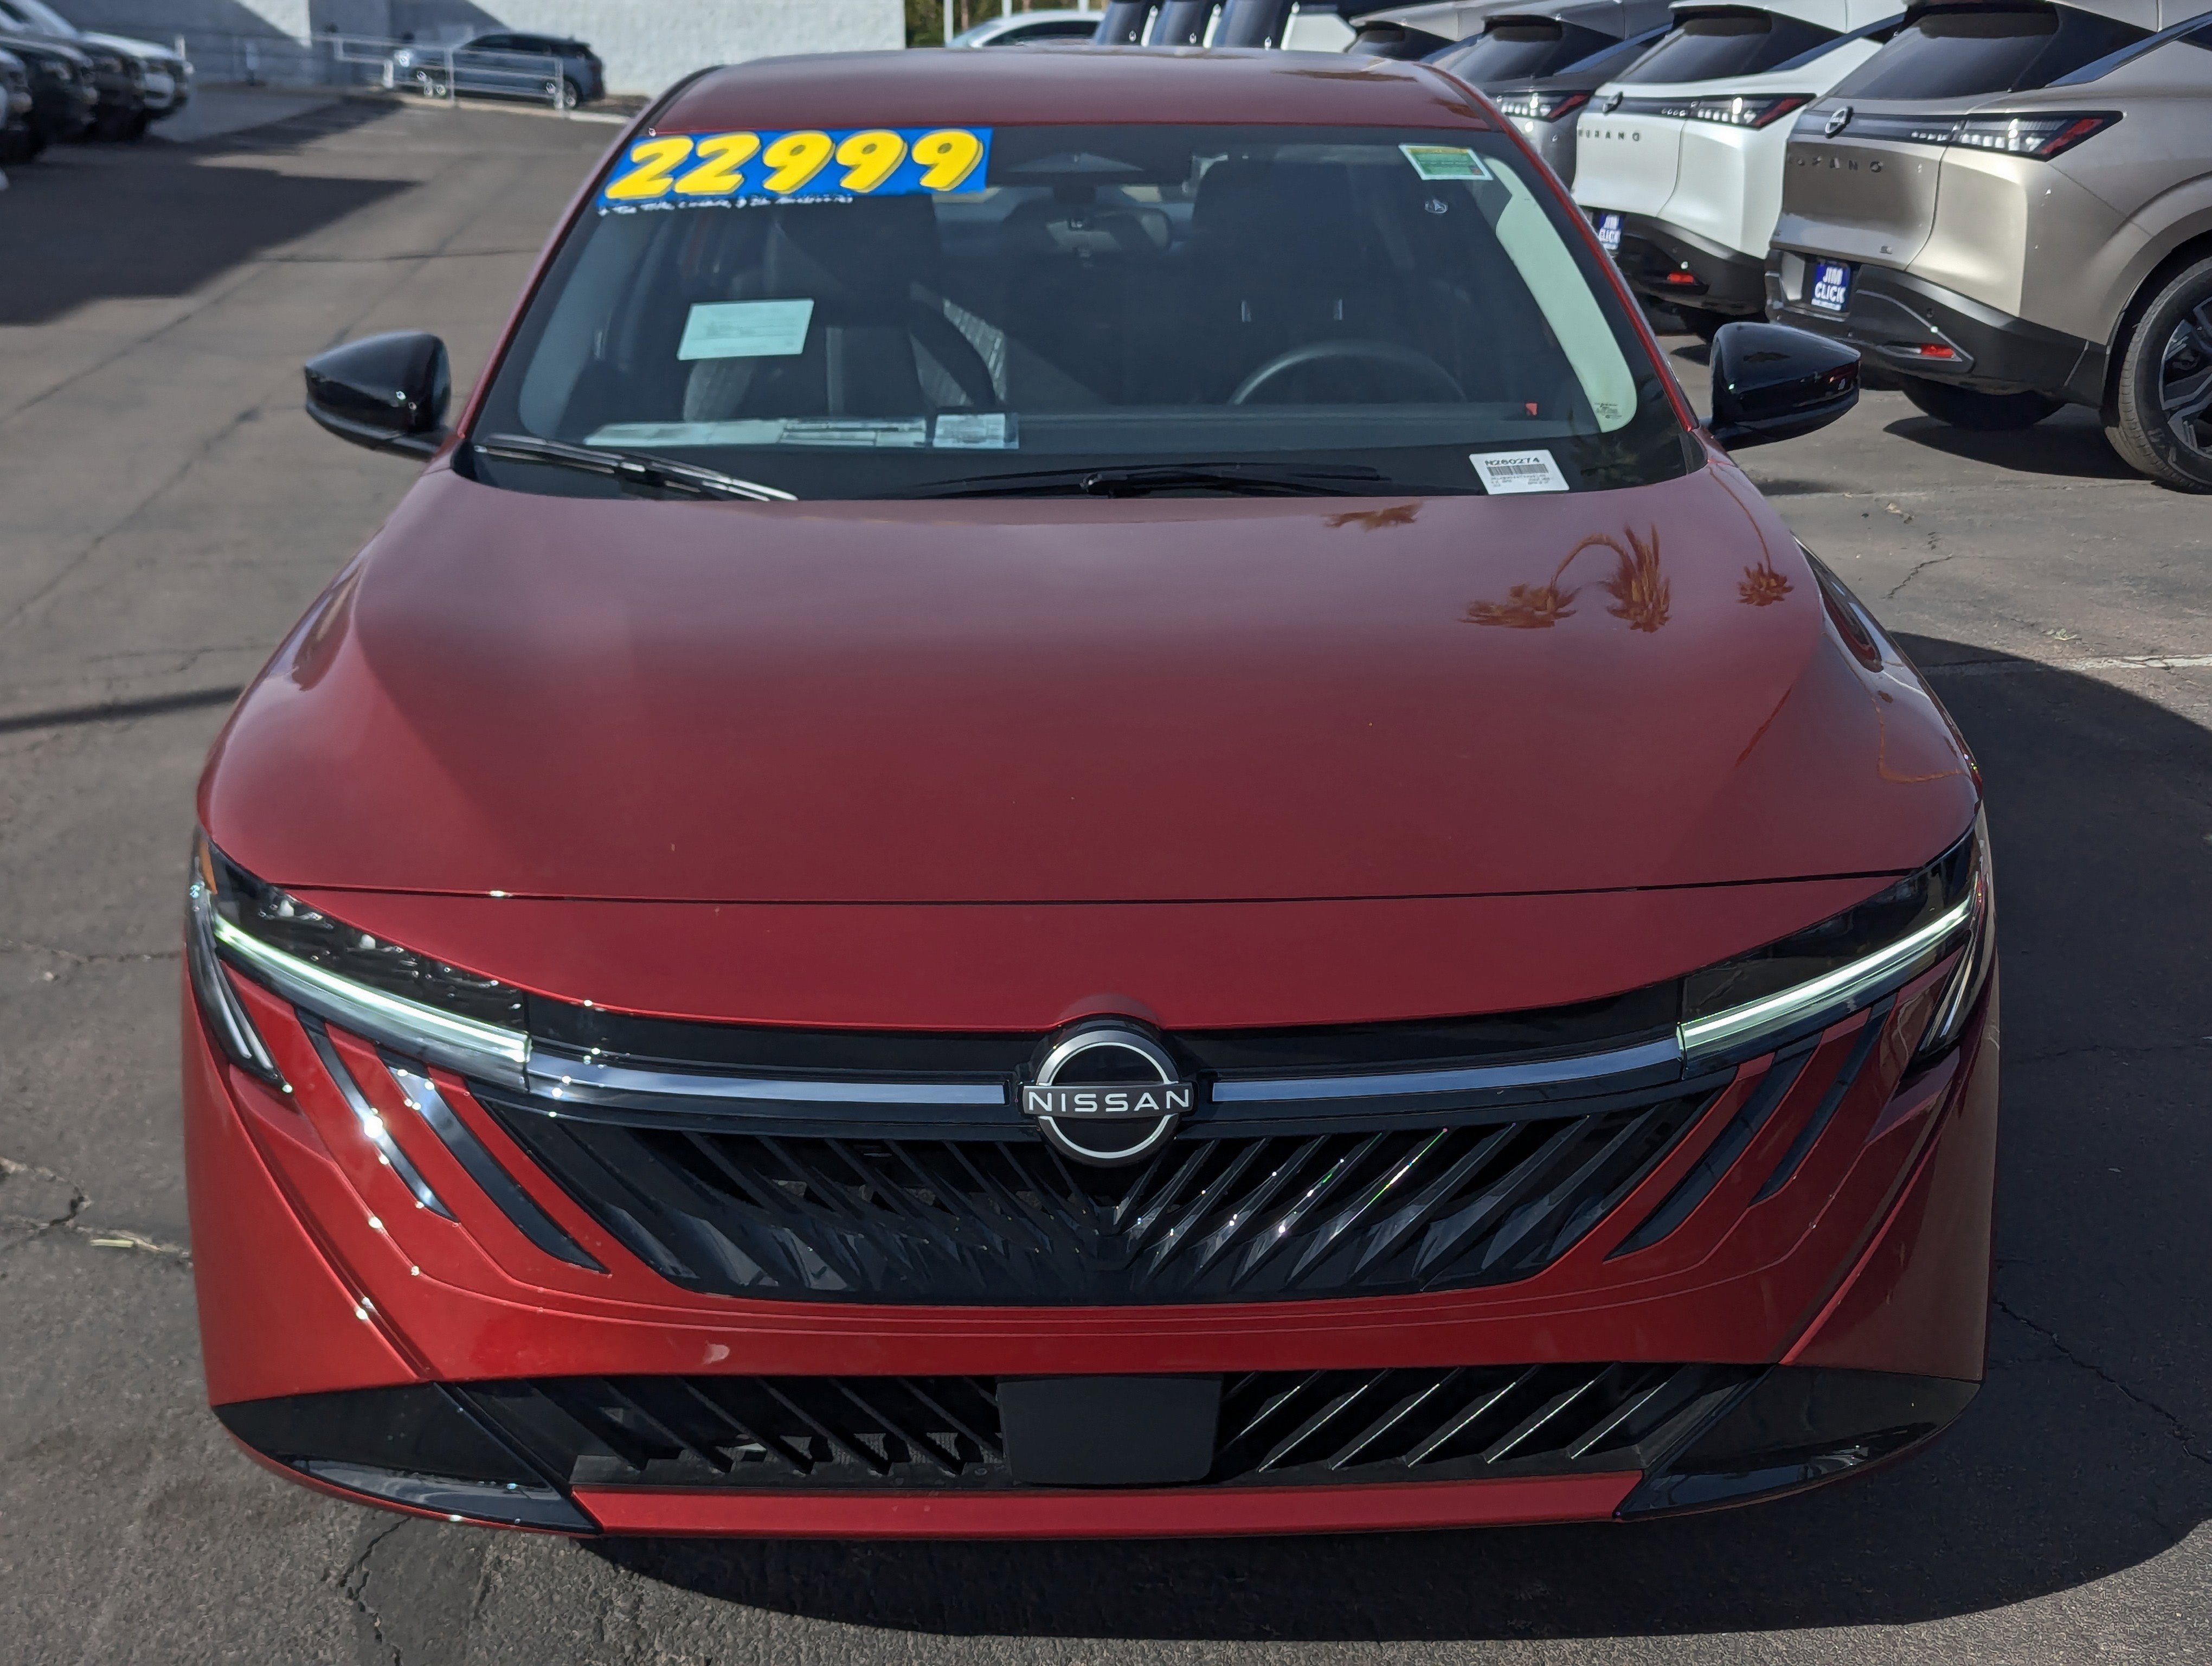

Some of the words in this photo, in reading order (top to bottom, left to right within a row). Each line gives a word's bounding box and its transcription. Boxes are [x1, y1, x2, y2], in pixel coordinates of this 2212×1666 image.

[605, 130, 983, 199] 22999
[1823, 266, 1843, 285] JIM
[1815, 281, 1846, 303] CLICK
[1028, 1088, 1189, 1112] NISSAN
